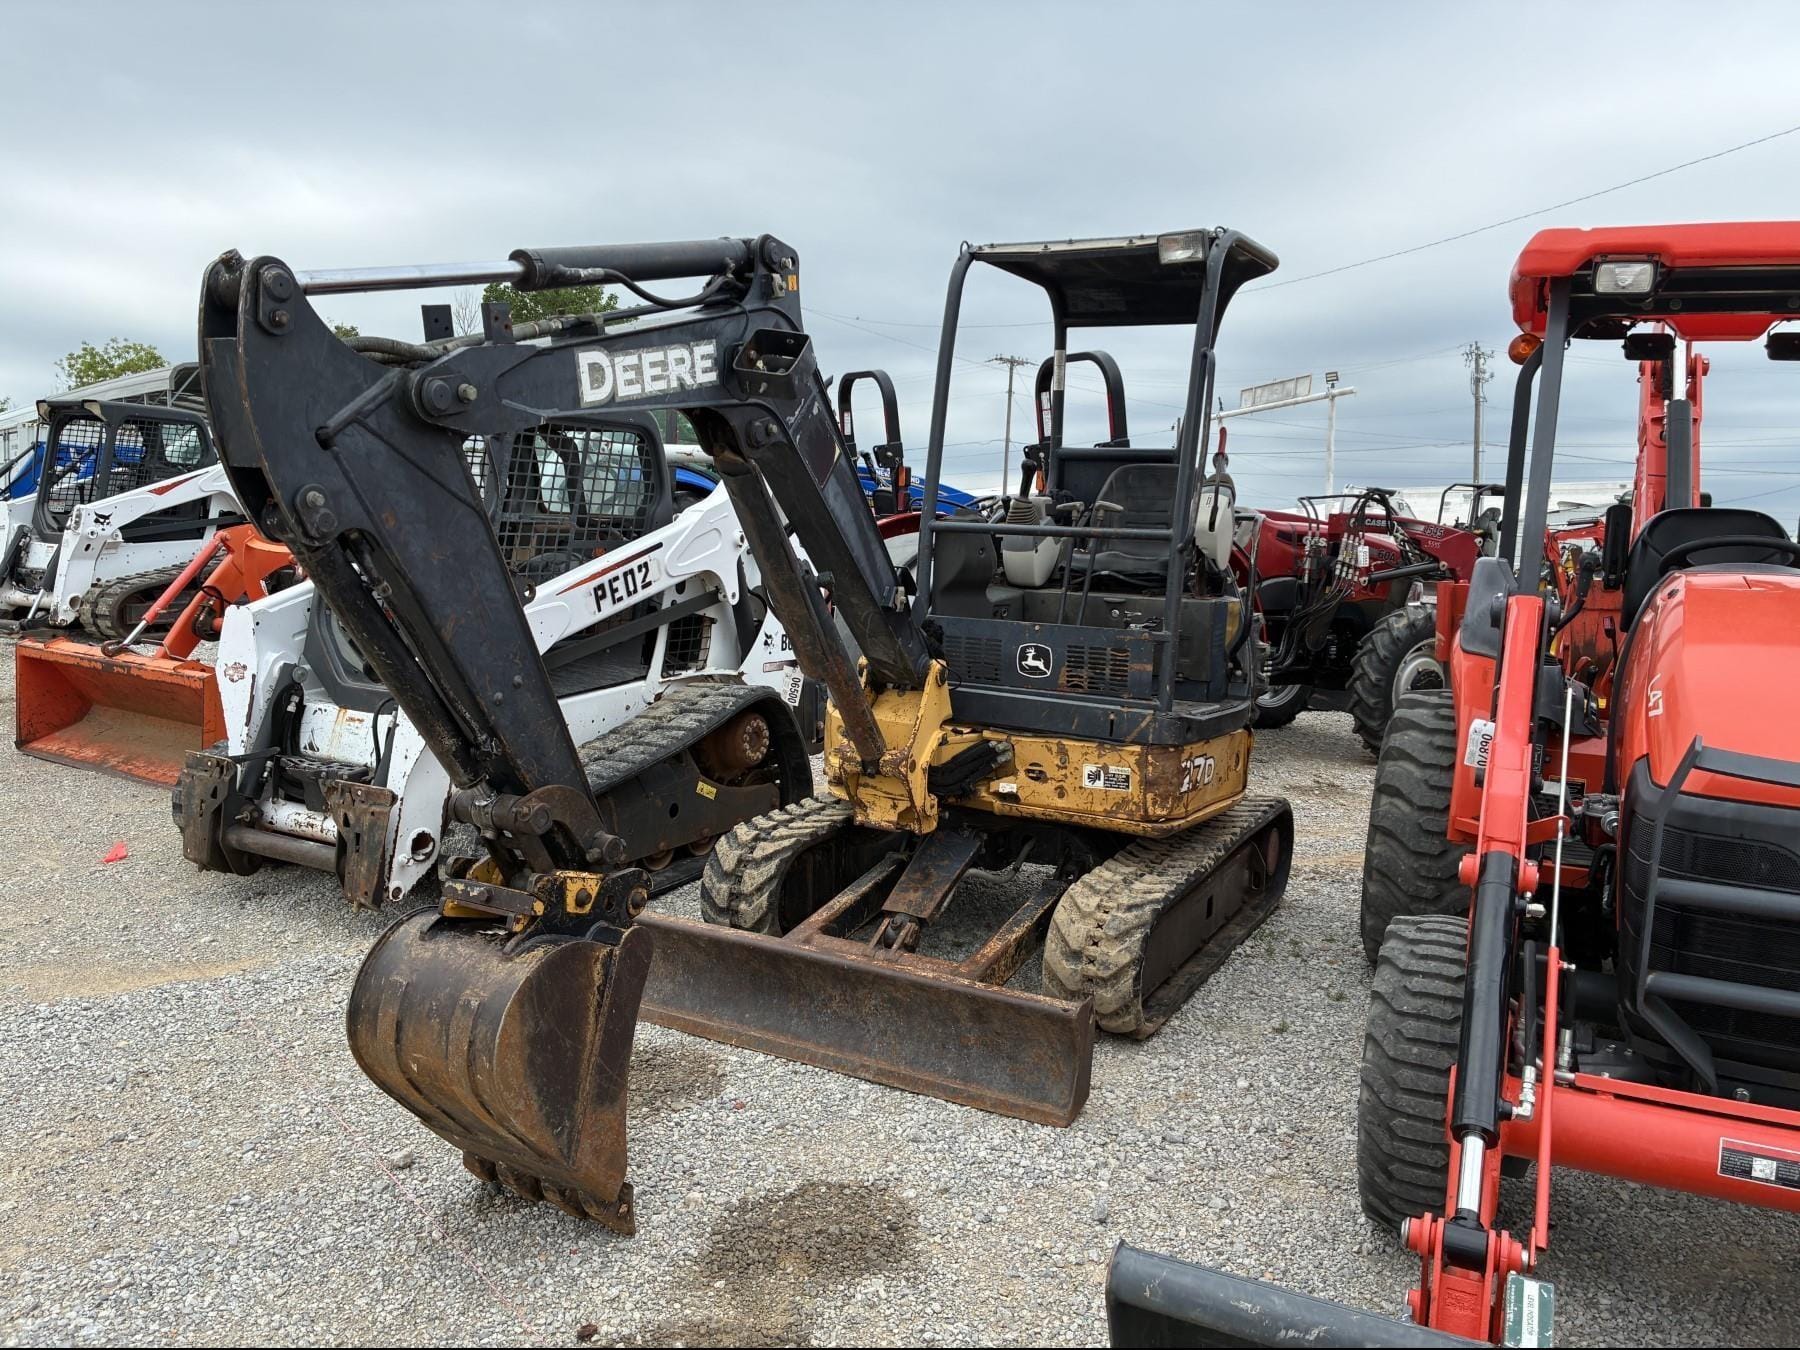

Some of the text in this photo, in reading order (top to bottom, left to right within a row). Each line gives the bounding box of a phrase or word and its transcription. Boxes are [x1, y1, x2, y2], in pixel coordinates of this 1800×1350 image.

[578, 344, 717, 403] DEERE
[1365, 518, 1386, 527] CASE
[788, 677, 801, 704] 06500
